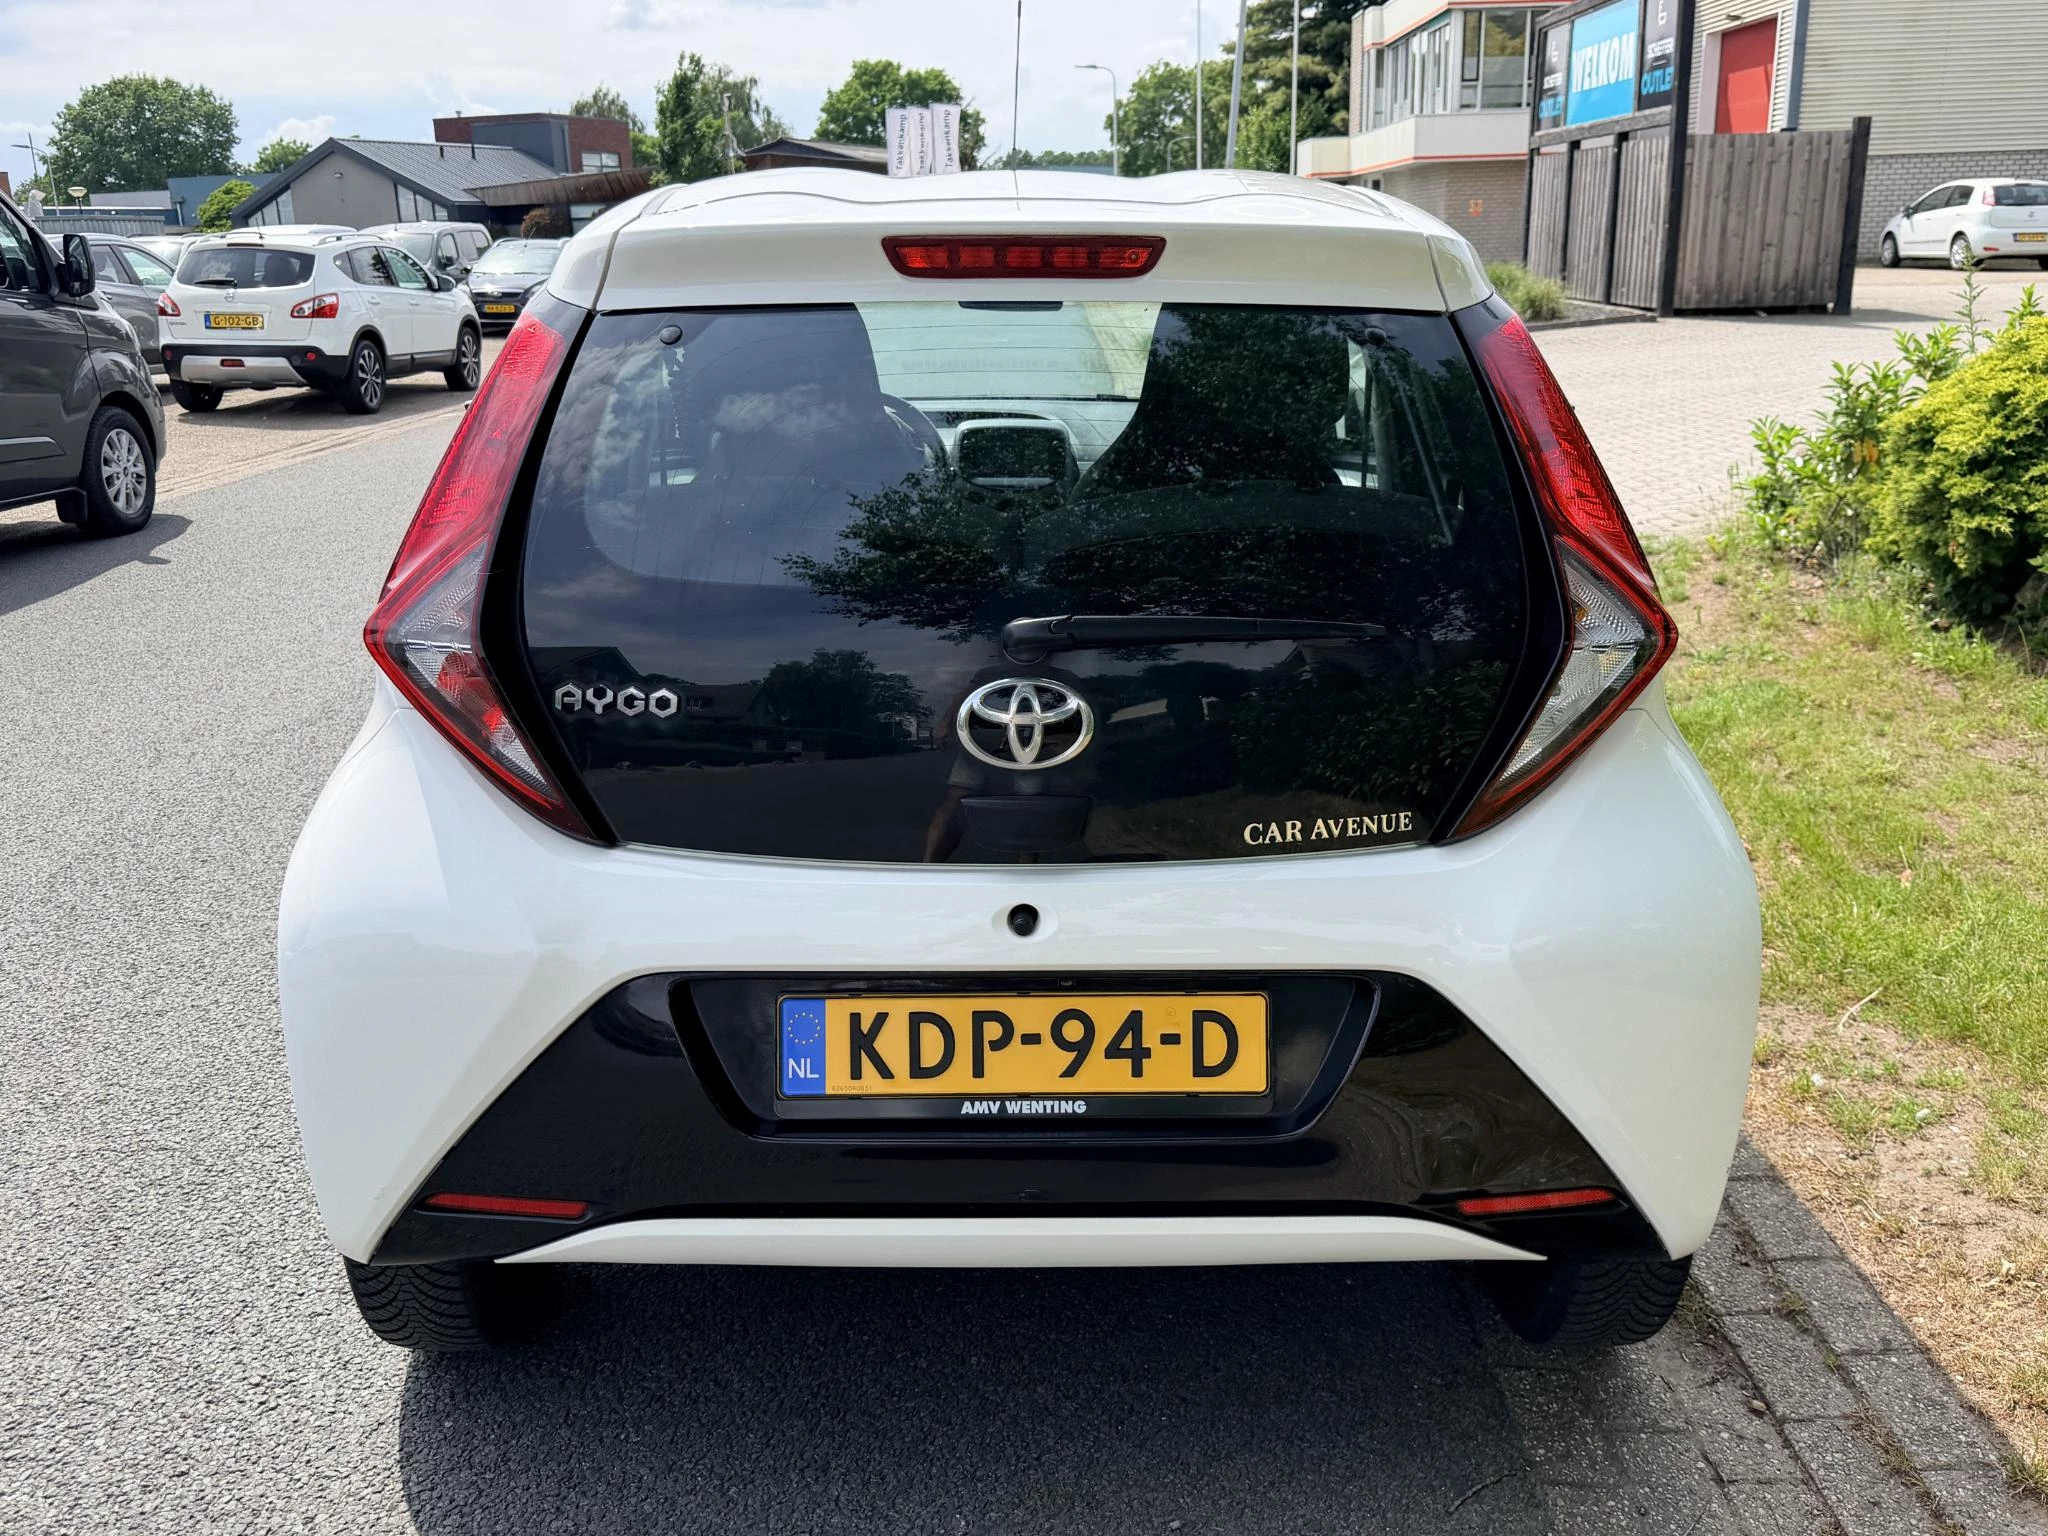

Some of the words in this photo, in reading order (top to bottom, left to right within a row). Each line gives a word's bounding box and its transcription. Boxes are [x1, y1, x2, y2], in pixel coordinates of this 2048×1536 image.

[1571, 32, 1635, 93] WELKOM
[213, 316, 260, 326] G-102-GB
[555, 683, 678, 718] AYGO
[1243, 820, 1303, 845] CAR
[1310, 811, 1413, 840] AVENUE
[849, 1009, 1239, 1080] KDP-94-D
[788, 1058, 819, 1079] NL
[961, 1100, 1001, 1114] AMV
[1005, 1100, 1087, 1114] WENTING
